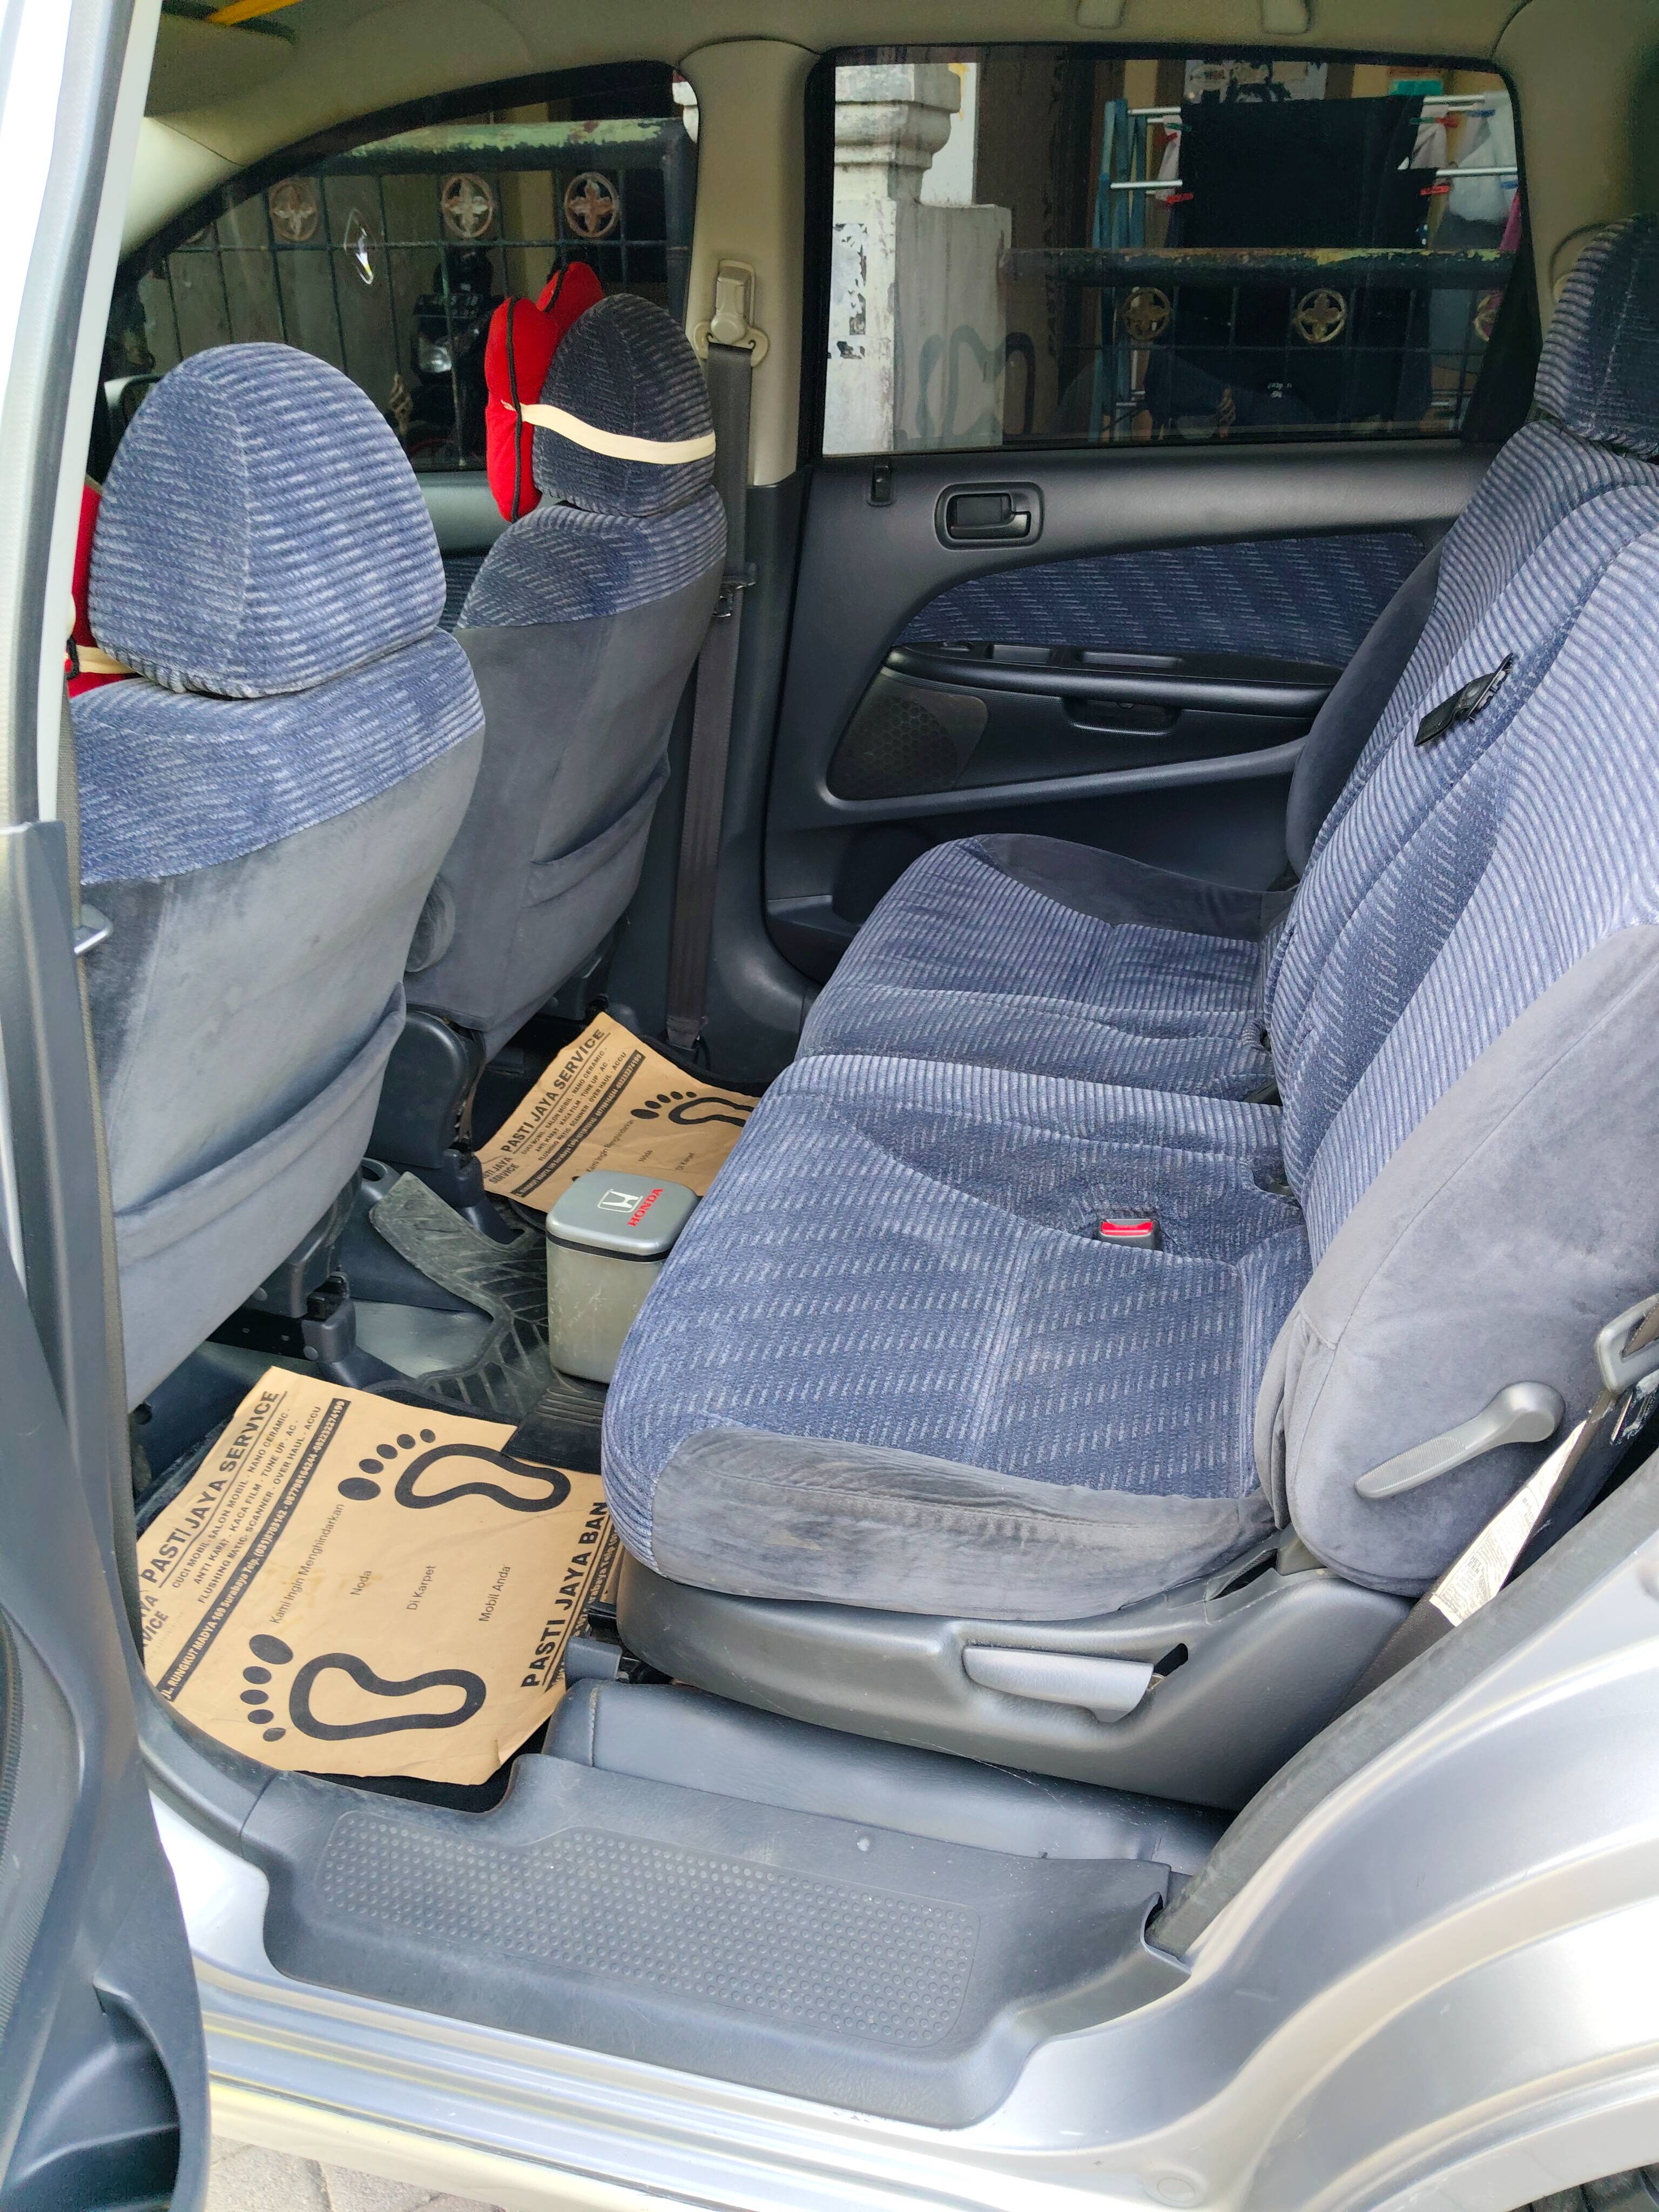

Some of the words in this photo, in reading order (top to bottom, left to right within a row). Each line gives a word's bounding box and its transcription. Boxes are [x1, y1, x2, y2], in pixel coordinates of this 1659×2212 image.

[500, 1121, 535, 1152] PASTI
[530, 1091, 559, 1122] JAYA
[554, 1029, 605, 1090] SERVICE
[493, 1157, 513, 1171] JAYA
[627, 1188, 664, 1227] HONDA
[140, 1528, 191, 1583] PASTI
[185, 1480, 228, 1529] JAYA
[219, 1391, 279, 1472] SERVICE
[172, 1568, 191, 1588] CUCI
[208, 1509, 231, 1539] SALON
[226, 1481, 248, 1508] MOBIL
[247, 1449, 266, 1473] NANO
[264, 1412, 288, 1448] CERAMIC
[193, 1563, 212, 1584] ANTI
[208, 1538, 230, 1561] KARAT
[229, 1506, 249, 1532] KACA
[245, 1483, 262, 1505] FILM
[261, 1454, 280, 1477] TUNE
[275, 1442, 286, 1458] UP
[287, 1424, 297, 1437] AC
[198, 1560, 231, 1603] FLUSHING
[245, 1491, 274, 1533] SCANNER
[273, 1461, 292, 1485] OVER
[291, 1438, 305, 1460] HAUL
[304, 1406, 321, 1430] ACCU
[140, 1595, 159, 1617] YA
[269, 1595, 292, 1624] Kami
[285, 1576, 305, 1602] Ingin
[298, 1503, 345, 1576] Menghindarkan
[350, 1570, 372, 1596] Noda
[406, 1597, 421, 1610] Di
[413, 1565, 436, 1597] Karpet
[478, 1591, 500, 1622] Mobil
[493, 1565, 511, 1591] Anda
[521, 1619, 566, 1688] PASTI
[555, 1552, 592, 1610] JAYA
[578, 1502, 608, 1545] BAN
[143, 1610, 168, 1647] VICE
[167, 1647, 199, 1687] RUNGKUT
[192, 1621, 218, 1650] MADYA
[220, 1573, 249, 1608] Surabaya
